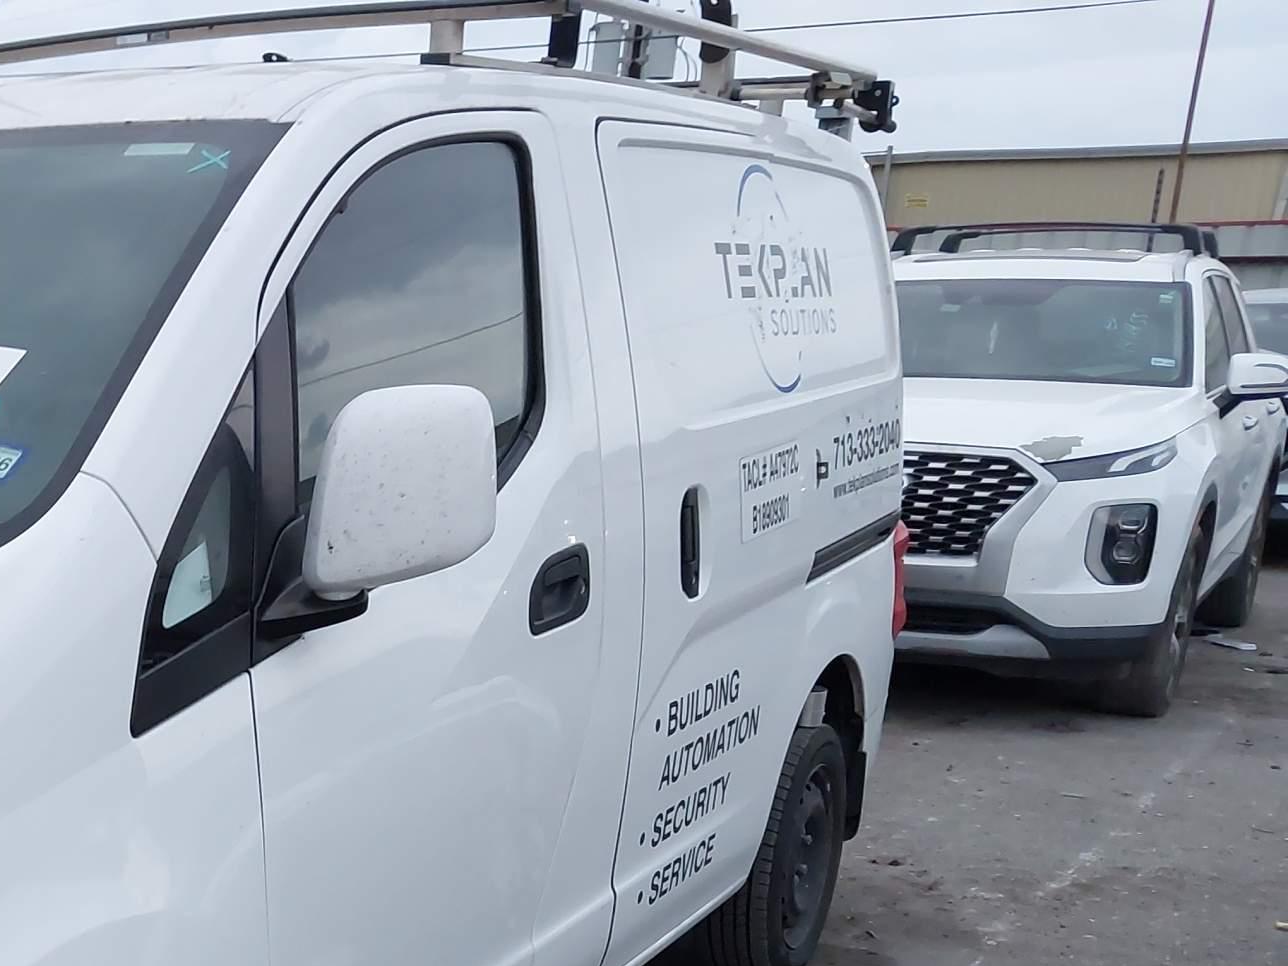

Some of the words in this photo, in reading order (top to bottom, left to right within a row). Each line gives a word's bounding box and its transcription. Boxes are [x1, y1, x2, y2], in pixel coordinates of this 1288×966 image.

[770, 307, 838, 336] SOLUTIONS
[833, 418, 900, 471] 713-333-2040
[667, 669, 740, 737] BUILDING
[658, 705, 760, 791] AUTOMATION
[651, 772, 730, 848] SECURITY
[648, 833, 716, 905] SERVICE
